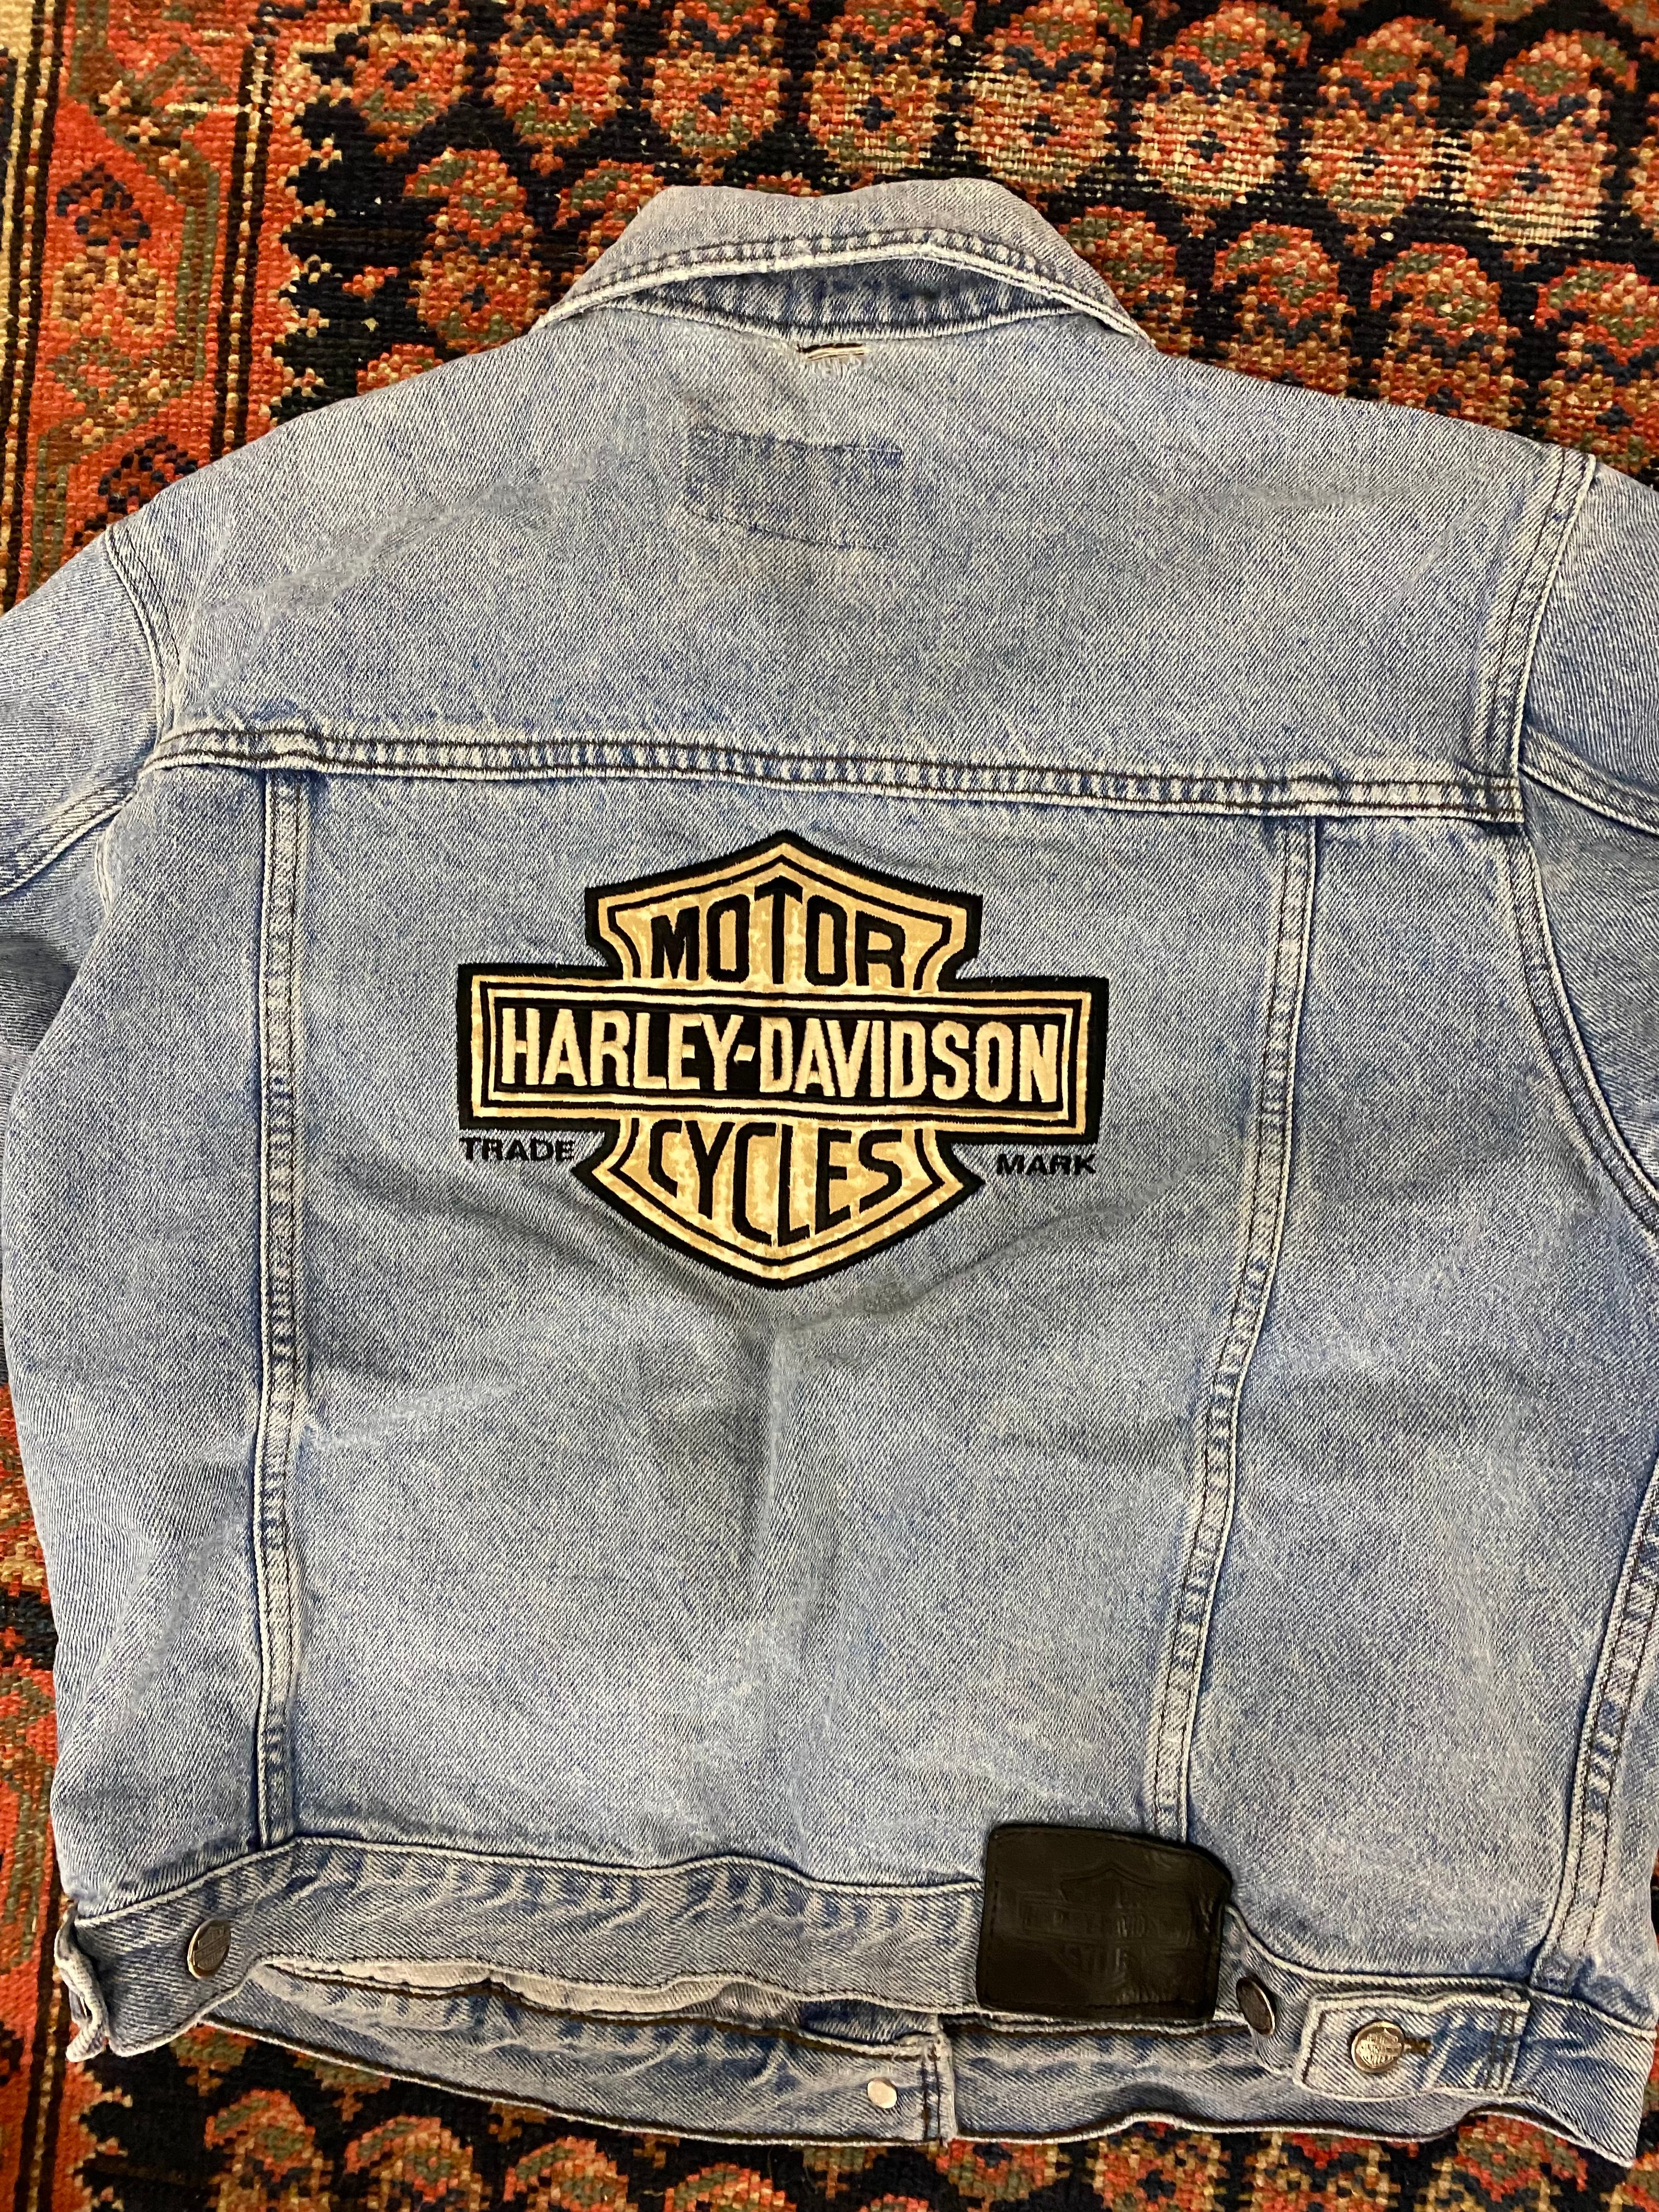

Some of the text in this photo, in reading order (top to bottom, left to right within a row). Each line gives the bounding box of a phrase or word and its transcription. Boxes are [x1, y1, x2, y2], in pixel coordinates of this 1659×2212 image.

[650, 875, 906, 988] MOTOR
[500, 1007, 1059, 1103] HARLEY-DAVIDSON
[460, 1137, 574, 1163] TRADE
[649, 1119, 904, 1247] CYCLES
[997, 1154, 1097, 1177] MARK
